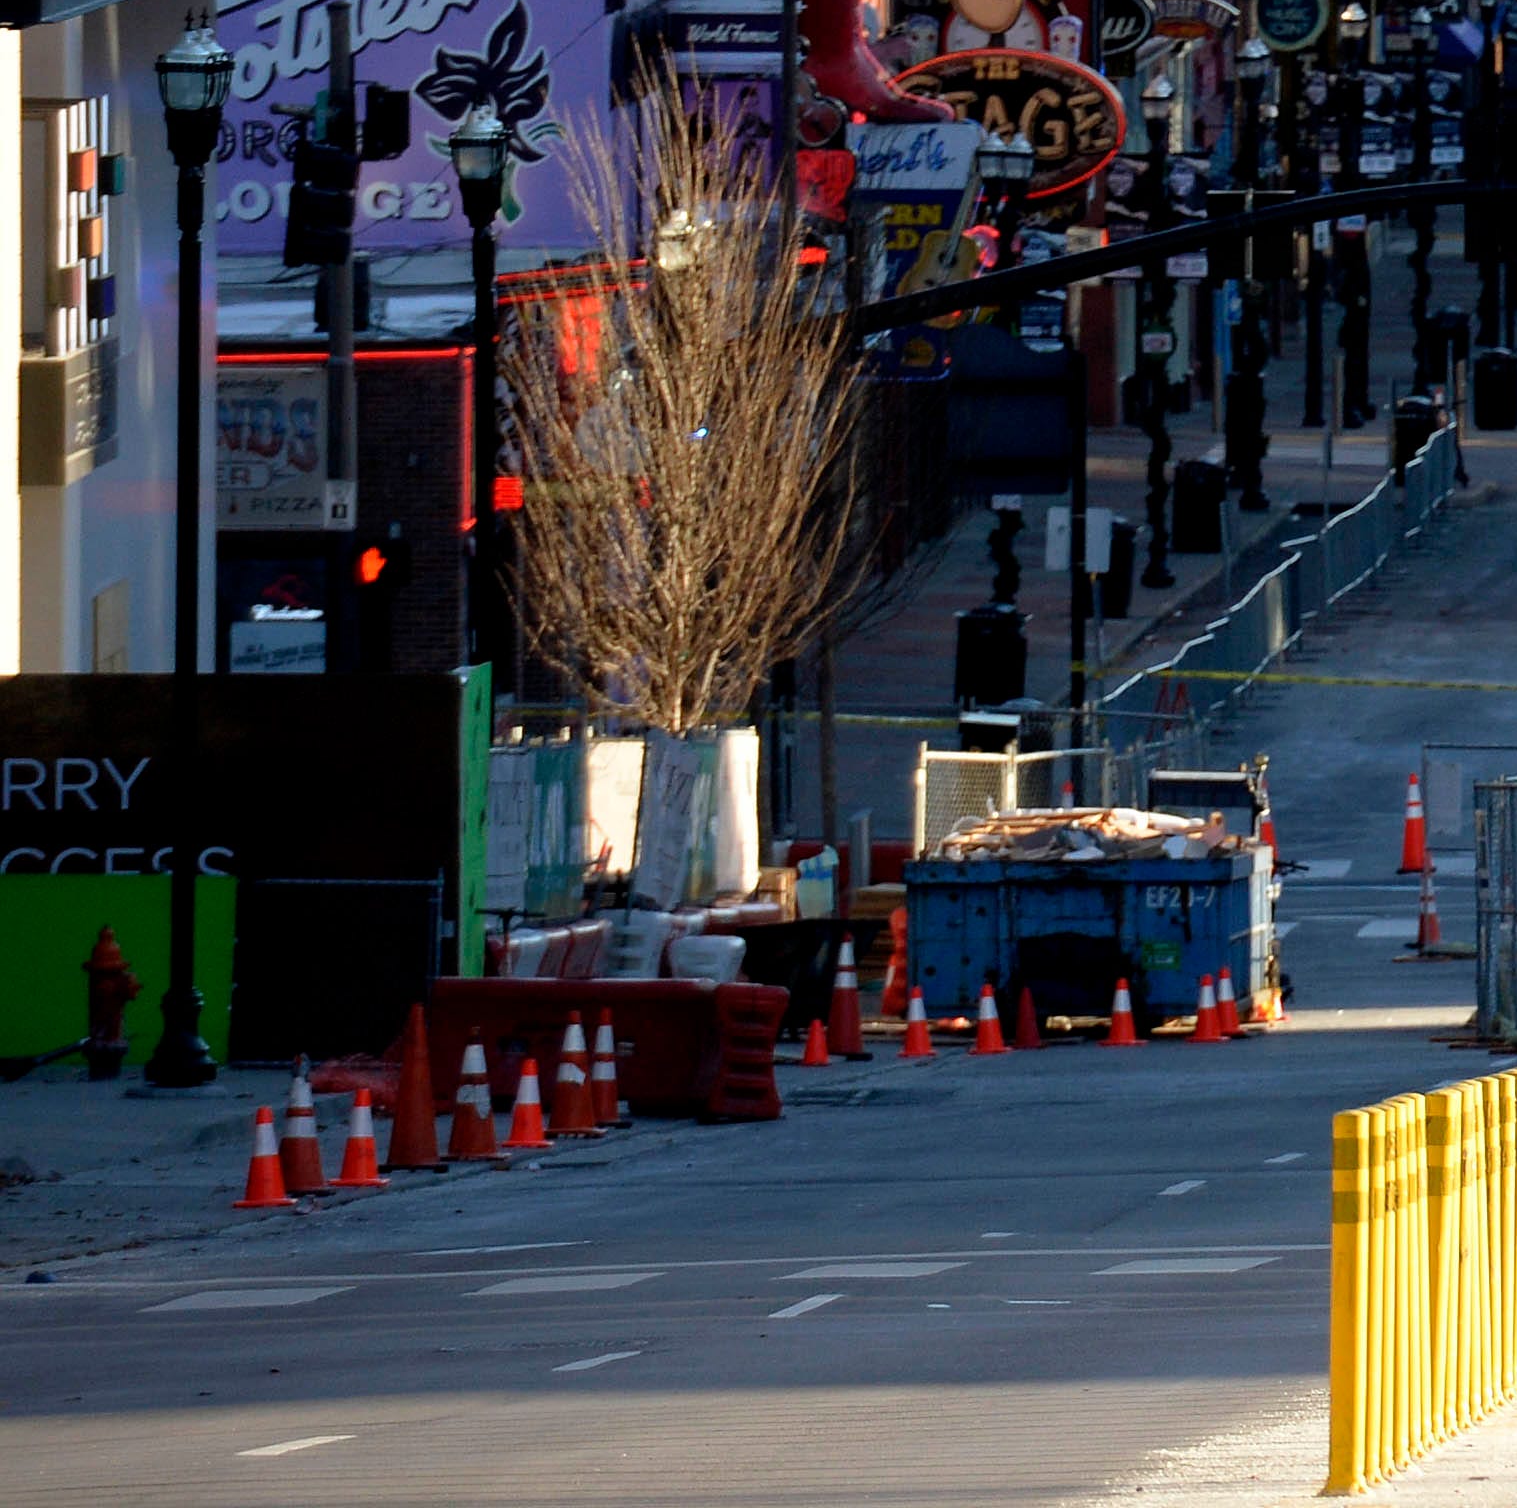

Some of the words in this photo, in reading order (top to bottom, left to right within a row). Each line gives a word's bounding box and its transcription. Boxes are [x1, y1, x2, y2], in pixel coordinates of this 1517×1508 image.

[971, 57, 1021, 81] THE
[251, 496, 323, 512] PIZZA
[0, 756, 152, 812] RRY
